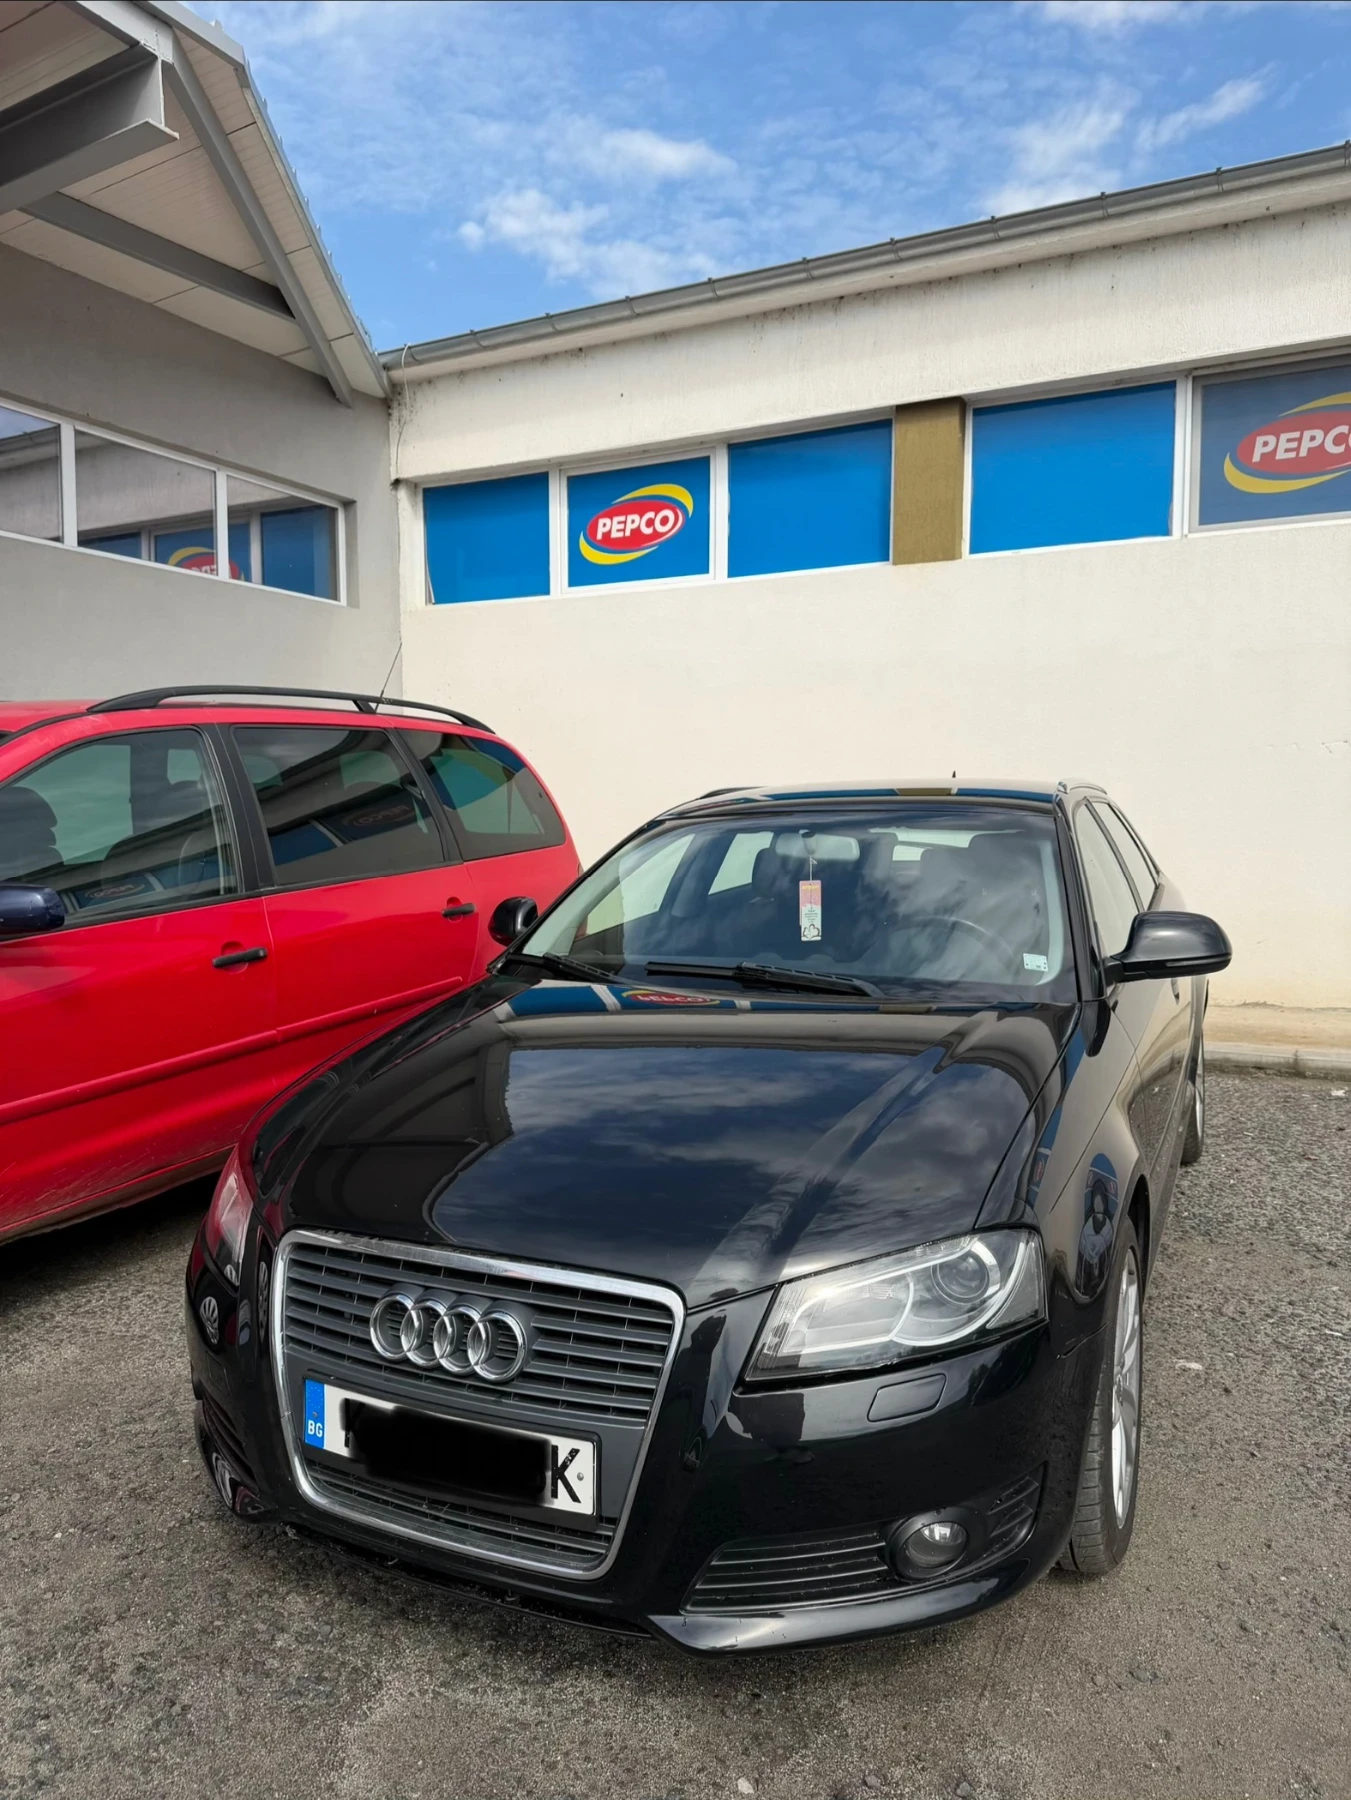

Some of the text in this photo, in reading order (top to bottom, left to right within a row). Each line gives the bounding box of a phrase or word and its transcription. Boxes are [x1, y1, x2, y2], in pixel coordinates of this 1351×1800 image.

[1251, 425, 1351, 463] PEPC
[596, 509, 675, 541] PEPCO
[308, 1419, 323, 1438] BG
